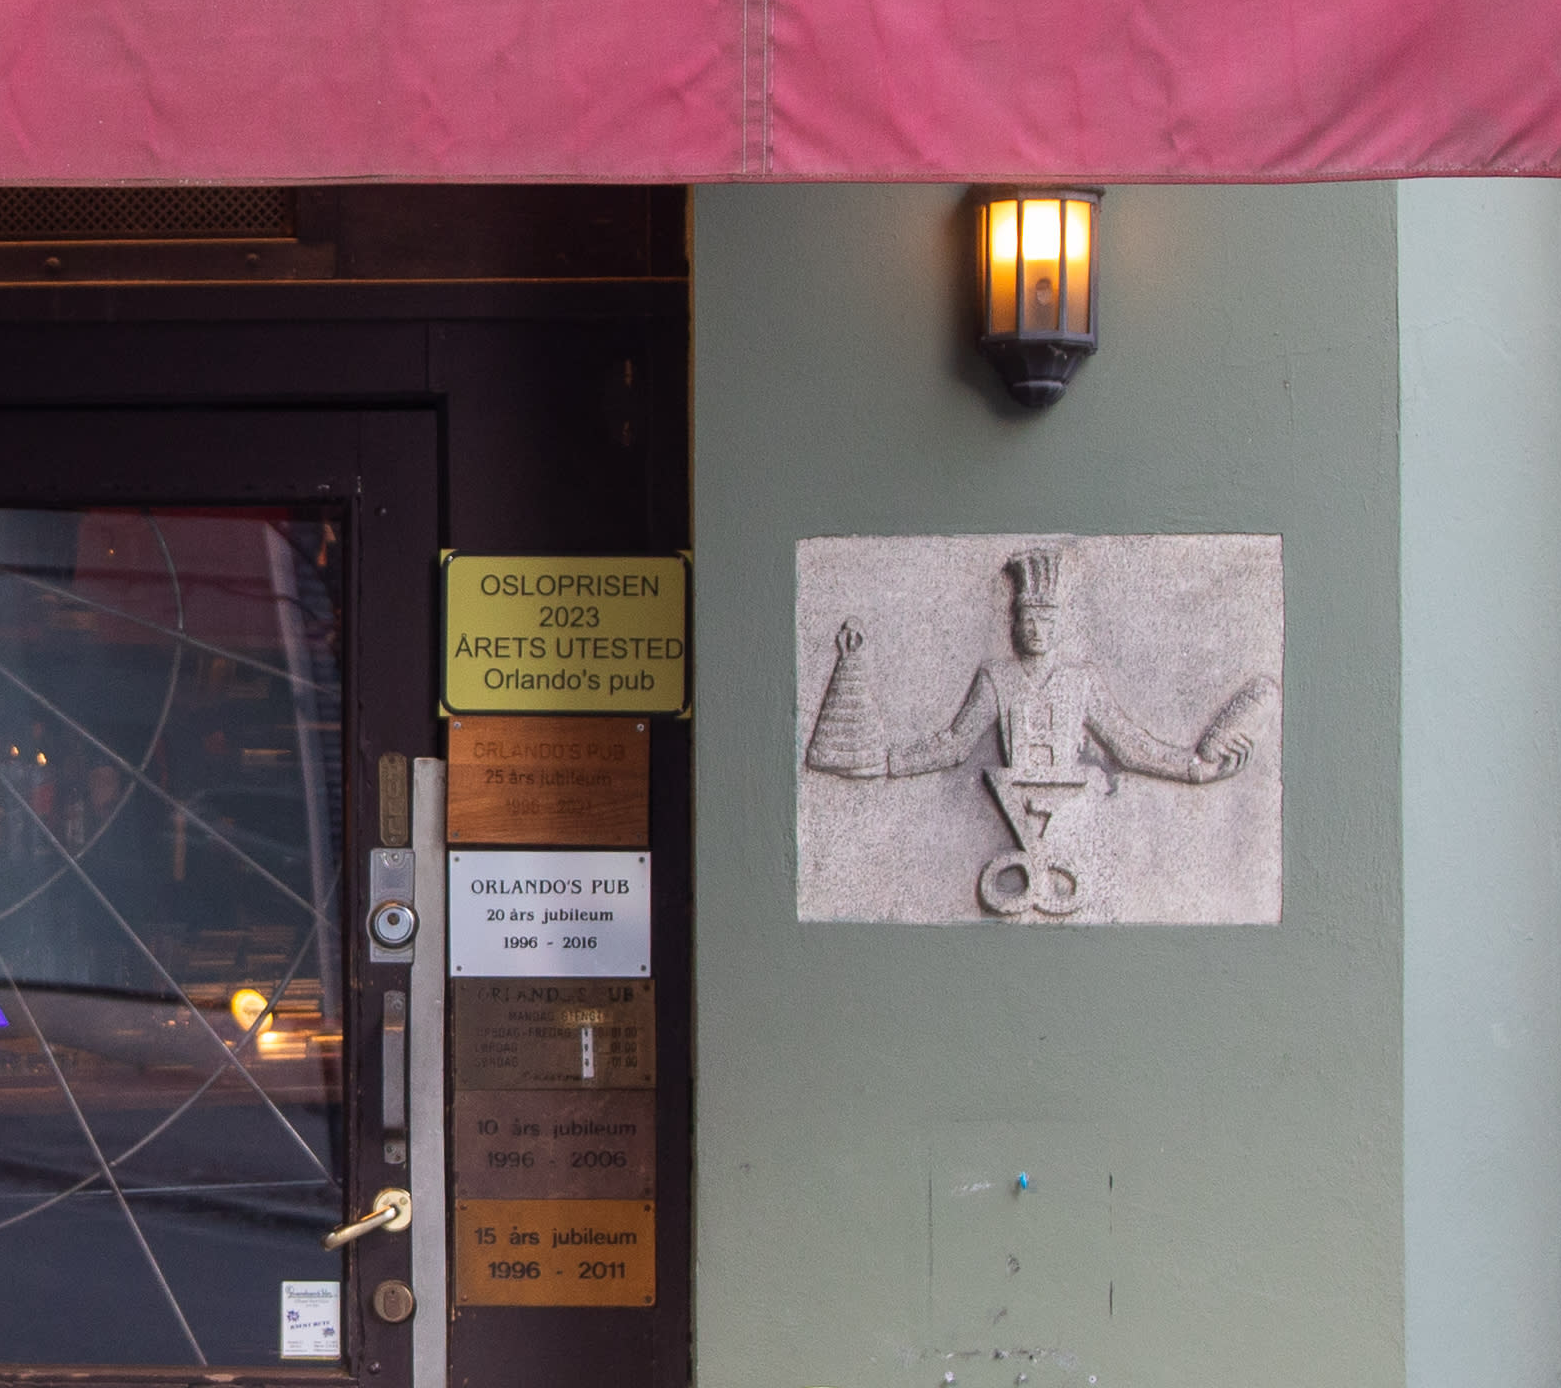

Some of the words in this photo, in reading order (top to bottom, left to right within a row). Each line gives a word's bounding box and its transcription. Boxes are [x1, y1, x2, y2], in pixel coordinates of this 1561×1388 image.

[480, 574, 660, 598] OSLOPRISEN
[538, 606, 601, 629] 2023
[455, 633, 547, 660] ÅRETS
[556, 637, 684, 661] UTESTED
[483, 668, 601, 692] Orlando's
[610, 669, 655, 695] pub
[588, 743, 626, 761] PUB
[485, 769, 504, 785] 25
[508, 769, 535, 785] års
[471, 879, 583, 895] ORLANDO'S
[591, 879, 630, 895] PUB
[487, 909, 506, 922] 20
[509, 908, 534, 921] års
[541, 908, 614, 924] jubileum
[503, 936, 538, 949] 1996
[562, 936, 598, 949] 2016
[478, 1119, 498, 1135] 10
[512, 1118, 541, 1136] års
[552, 1120, 637, 1138] jubileum
[488, 1151, 535, 1168] 1996
[571, 1151, 627, 1168] 2006
[474, 1227, 496, 1245] 15
[509, 1225, 540, 1245] års
[551, 1227, 637, 1248] jubileum
[488, 1262, 541, 1280] 1996
[578, 1261, 627, 1279] 2011
